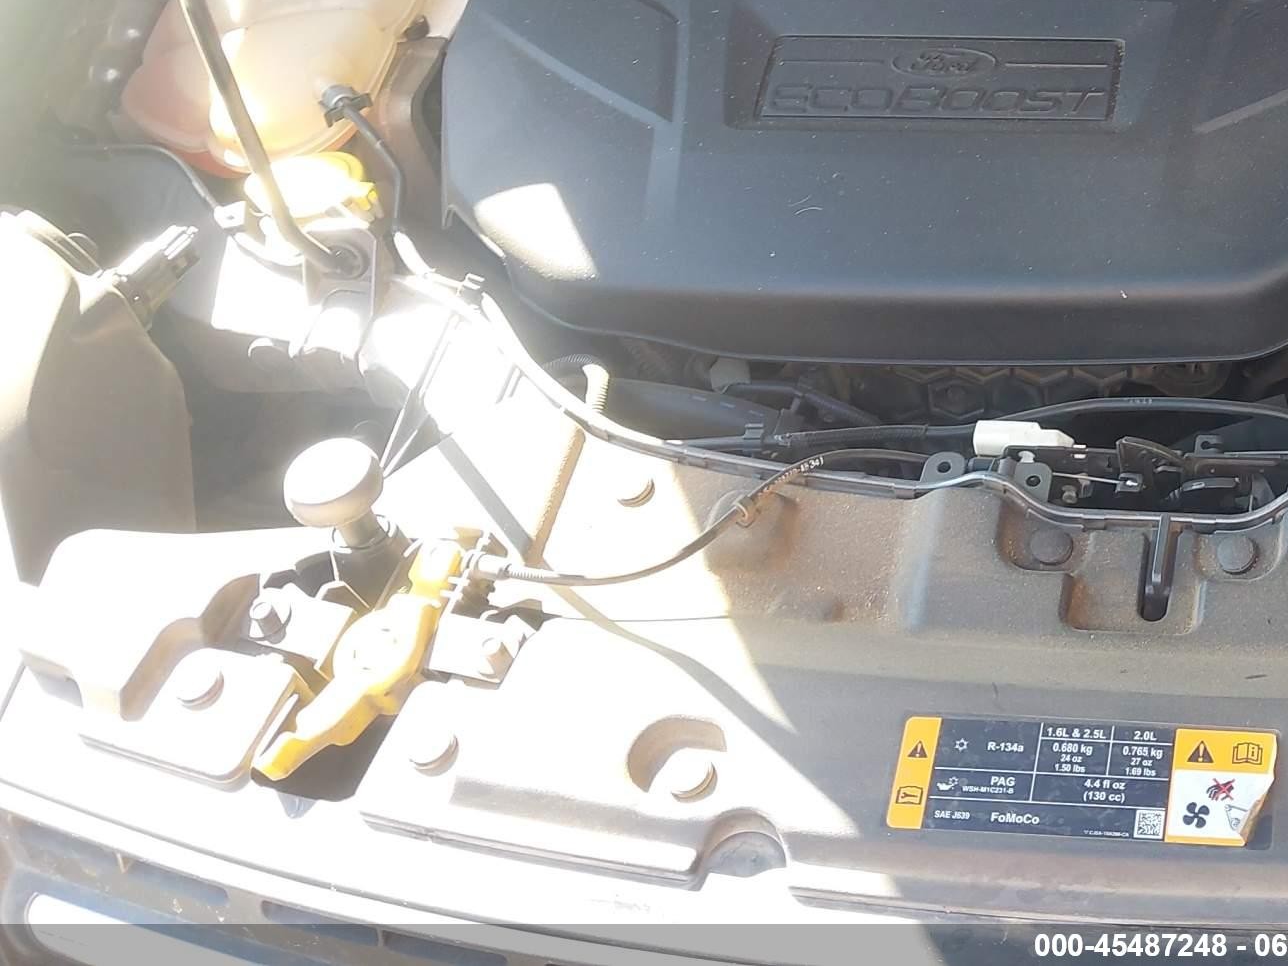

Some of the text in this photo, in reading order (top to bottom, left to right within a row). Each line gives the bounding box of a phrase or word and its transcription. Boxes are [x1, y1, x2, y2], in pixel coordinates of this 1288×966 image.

[771, 83, 1105, 114] ECOBOOST
[1046, 727, 1107, 739] 1.6L & 2.5L
[1133, 731, 1157, 741] 2.0L
[986, 741, 1024, 753] R-134a
[1052, 742, 1093, 756] 0.680 kg
[1122, 746, 1163, 759] 0.765 kg
[1060, 754, 1071, 762] 24
[1130, 757, 1140, 766] 27
[1054, 763, 1086, 773] 1.50 lbs
[1143, 768, 1156, 777] lbs
[990, 776, 1016, 787] PAG
[1083, 778, 1126, 790] 4.4 fl oz
[1083, 791, 1126, 804] (130 cc)
[934, 810, 951, 819] SAE
[990, 812, 1040, 825] FoMoCo
